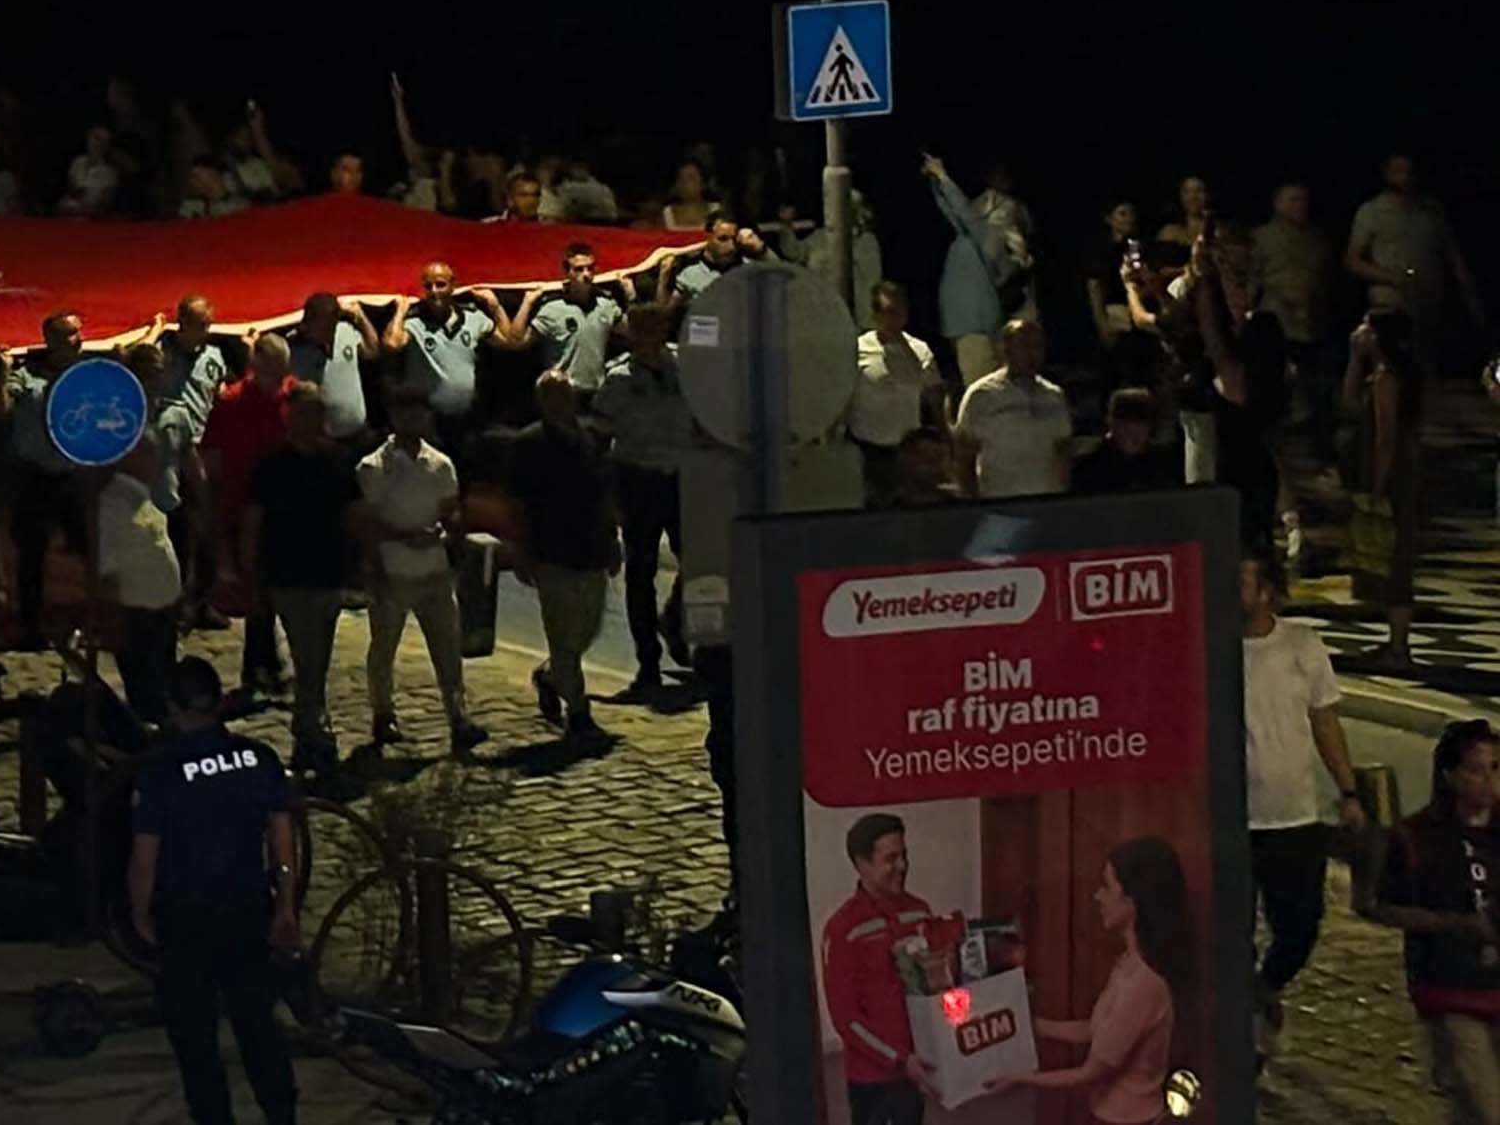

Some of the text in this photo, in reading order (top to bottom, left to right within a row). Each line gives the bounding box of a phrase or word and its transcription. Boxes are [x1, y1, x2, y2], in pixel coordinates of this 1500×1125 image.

[852, 582, 1017, 624] Yemeksepeti
[963, 650, 1033, 692] BİM
[907, 693, 1100, 735] raf fiyatına
[865, 727, 1148, 779] Yemeksepeti'nde
